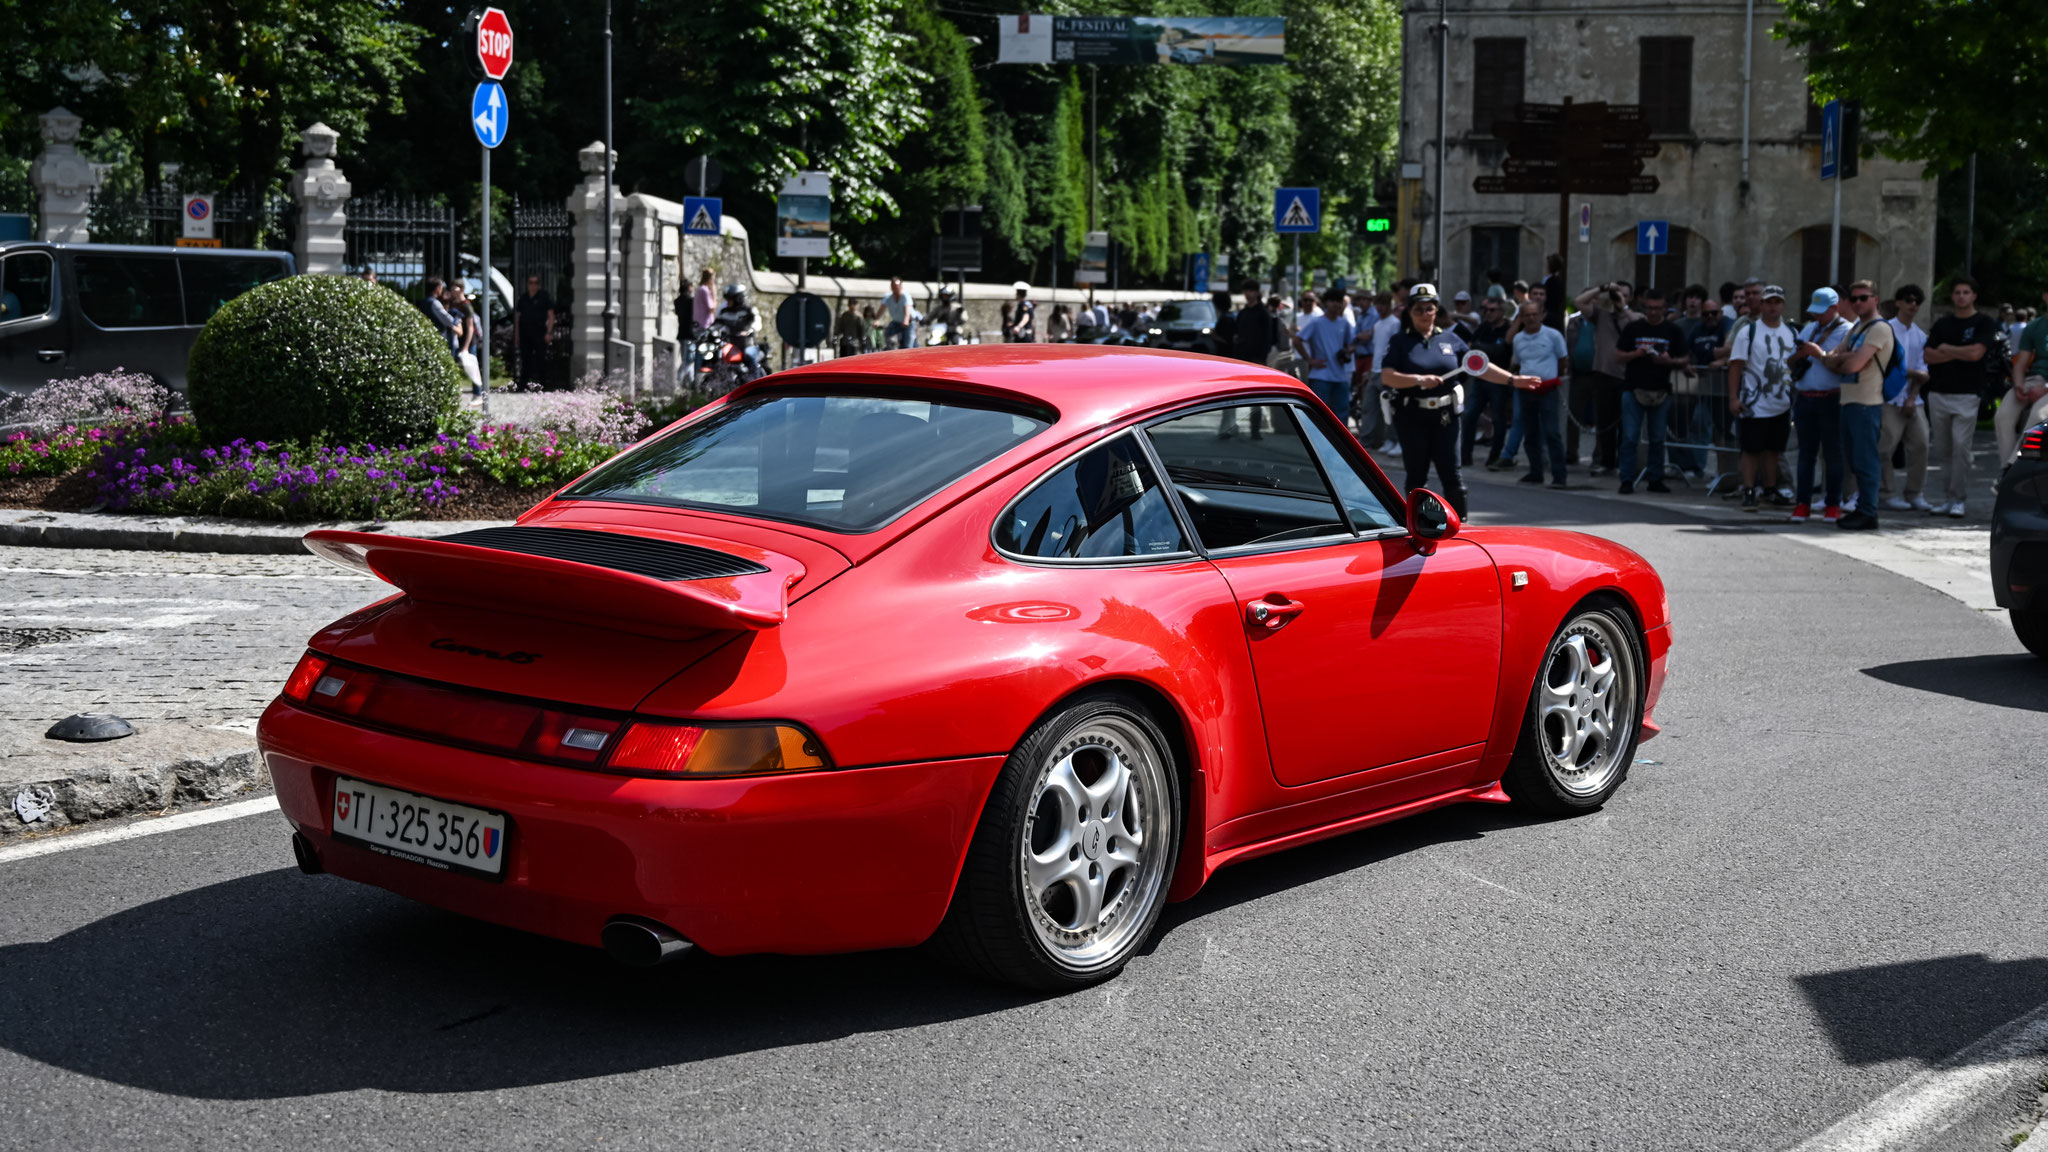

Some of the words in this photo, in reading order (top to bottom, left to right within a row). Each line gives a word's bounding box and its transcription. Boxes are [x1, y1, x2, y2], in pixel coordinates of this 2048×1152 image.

[1071, 21, 1129, 31] FESTIVAL
[481, 28, 511, 59] STOP
[429, 638, 503, 661] Carrera
[390, 849, 425, 864] BORRADORI
